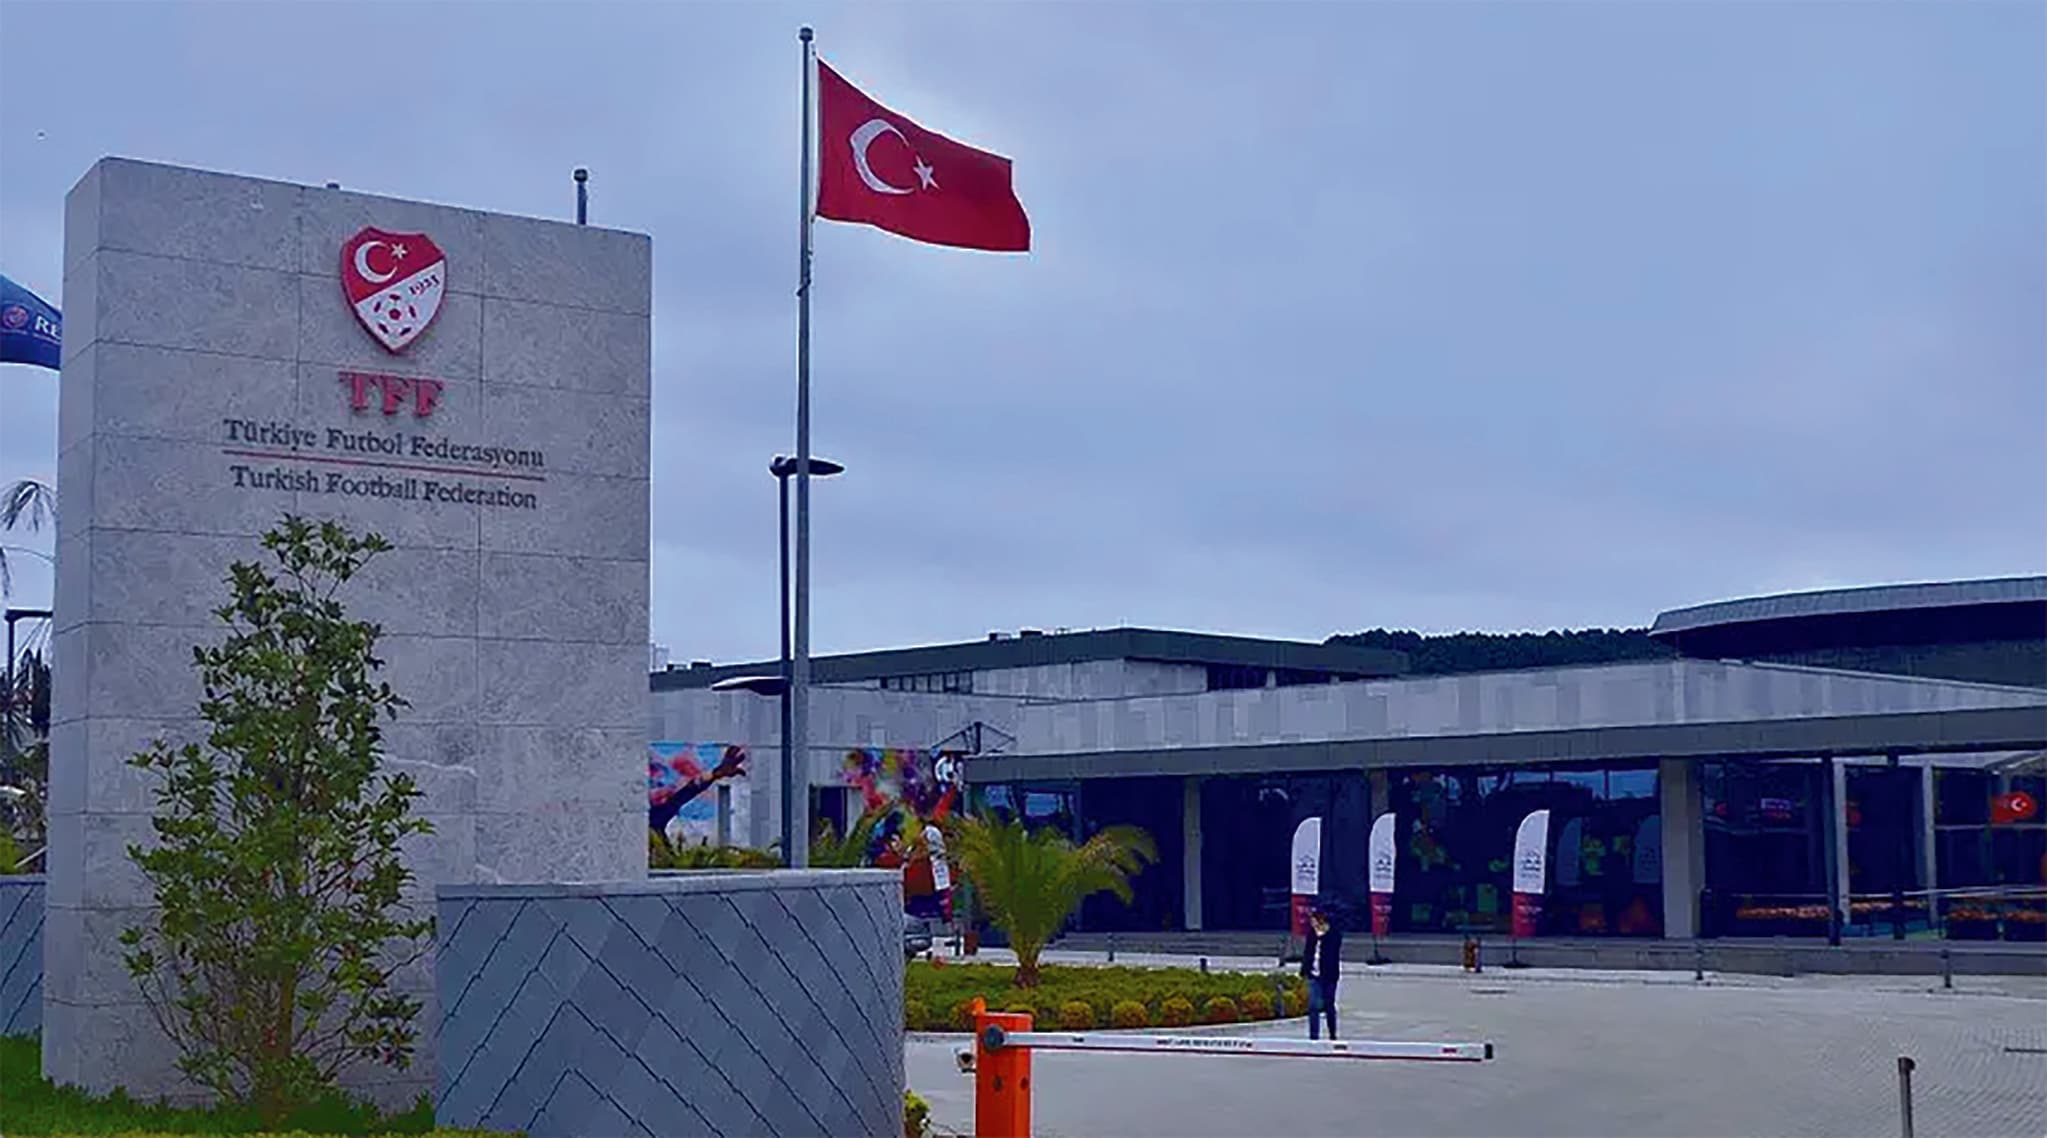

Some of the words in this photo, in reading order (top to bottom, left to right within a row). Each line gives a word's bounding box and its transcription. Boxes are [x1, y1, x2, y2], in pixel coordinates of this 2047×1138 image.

[338, 370, 444, 419] TFF
[223, 417, 317, 451] Türkiye
[326, 426, 403, 456] Futbol
[410, 435, 545, 468] Federasyonu
[229, 464, 319, 494] Turkish
[324, 473, 417, 501] Football
[421, 480, 537, 510] Federation
